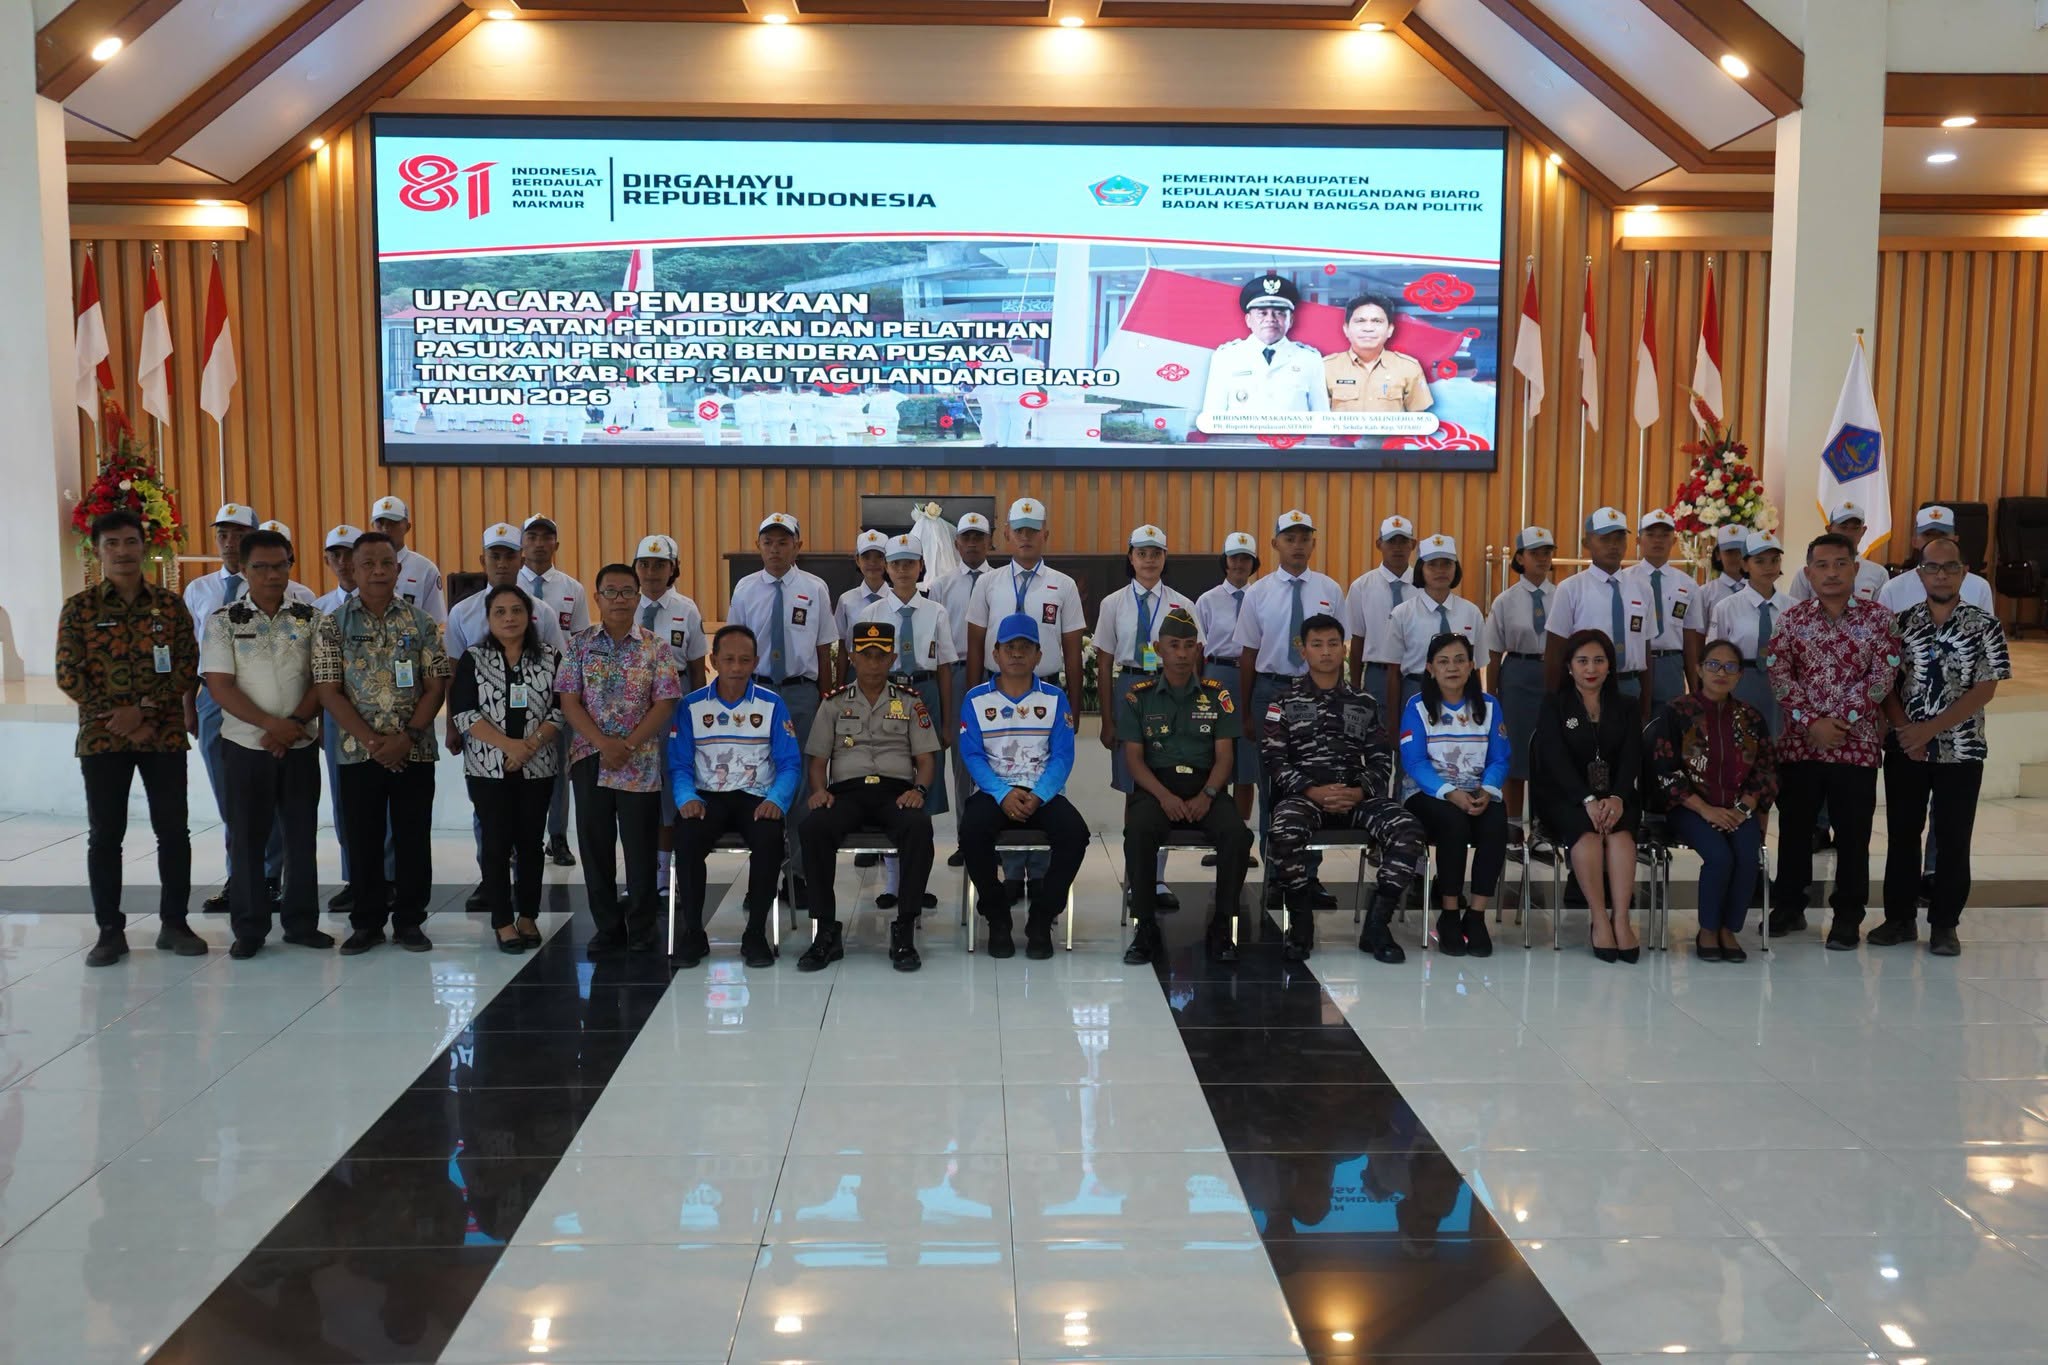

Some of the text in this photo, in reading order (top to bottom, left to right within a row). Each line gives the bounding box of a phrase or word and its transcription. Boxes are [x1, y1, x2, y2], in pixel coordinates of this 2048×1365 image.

[511, 167, 597, 176] INDONESIA
[1162, 174, 1370, 185] PEMERINTAH KABUPATEN
[398, 154, 499, 220] 81
[511, 178, 604, 187] BERDAULAT
[623, 173, 793, 189] DIRGAHAYU
[511, 189, 584, 198] ADIL DAN
[623, 190, 937, 208] REPUBLIK INDONESIA
[1162, 187, 1480, 199] KEPULAUAN SIAU TAGULANDANG BIARO
[512, 200, 585, 209] MAKMUR
[1162, 200, 1484, 212] BADAN KESATUAN BANGSA DAN POLITIK
[414, 289, 869, 314] UPACARA PEMBUKAAN
[415, 317, 1050, 339] PEMUSATAN PENDIDIKAN DAN PELATIHAN
[416, 341, 1012, 362] PASUKAN PENGIBAR BENDERA PUSAKA
[416, 364, 1120, 387] TINGKAT KAB. KEP. SIAU TAGULANDANG BIARO
[416, 387, 611, 405] TAHUN 2026
